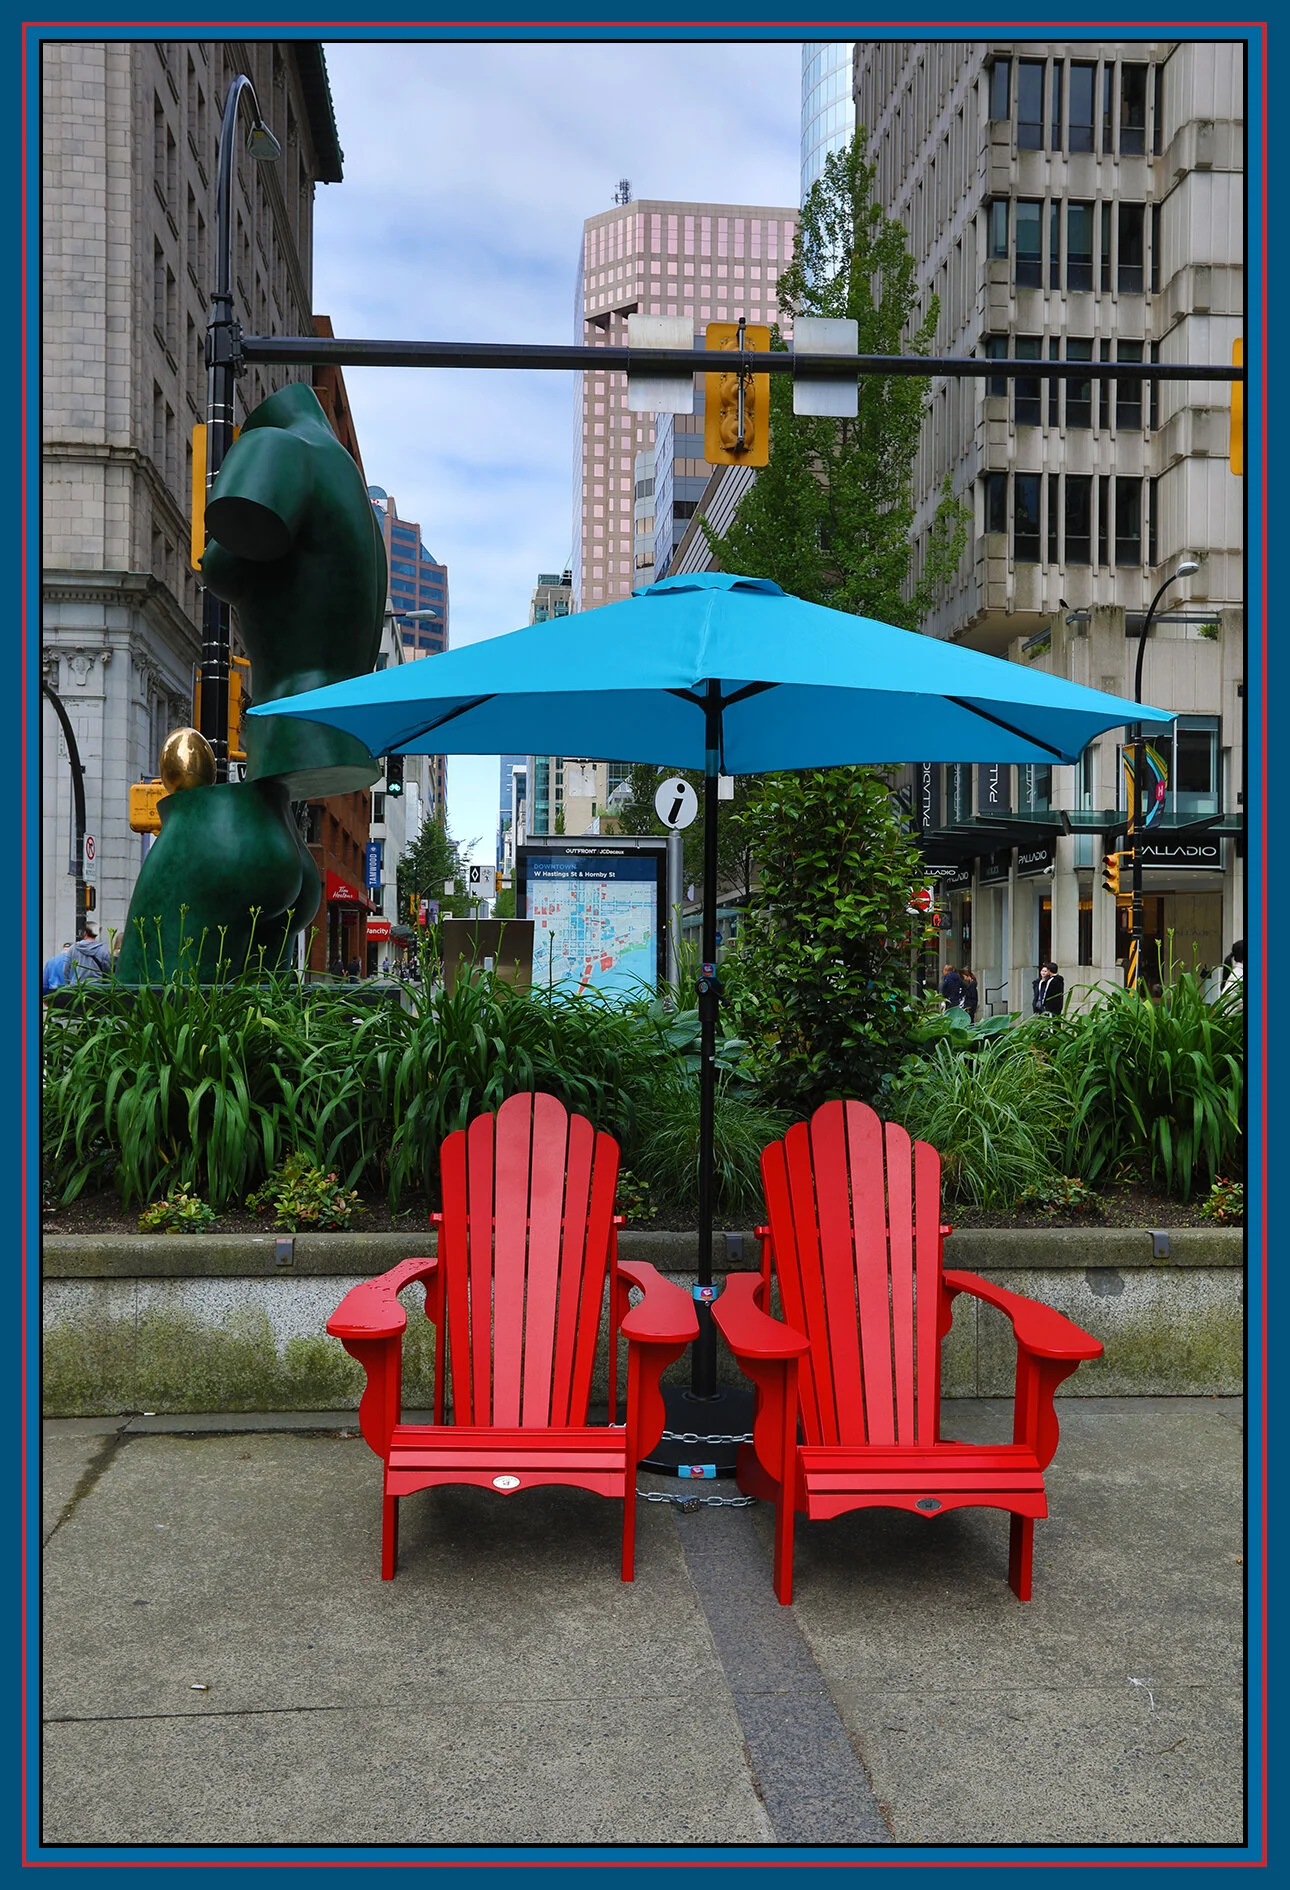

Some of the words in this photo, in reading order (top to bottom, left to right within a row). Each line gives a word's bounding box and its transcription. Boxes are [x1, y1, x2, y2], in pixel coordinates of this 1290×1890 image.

[1018, 850, 1048, 865] PALLADIO
[1141, 846, 1217, 857] ALLADIO
[369, 853, 377, 885] TAMWOOD
